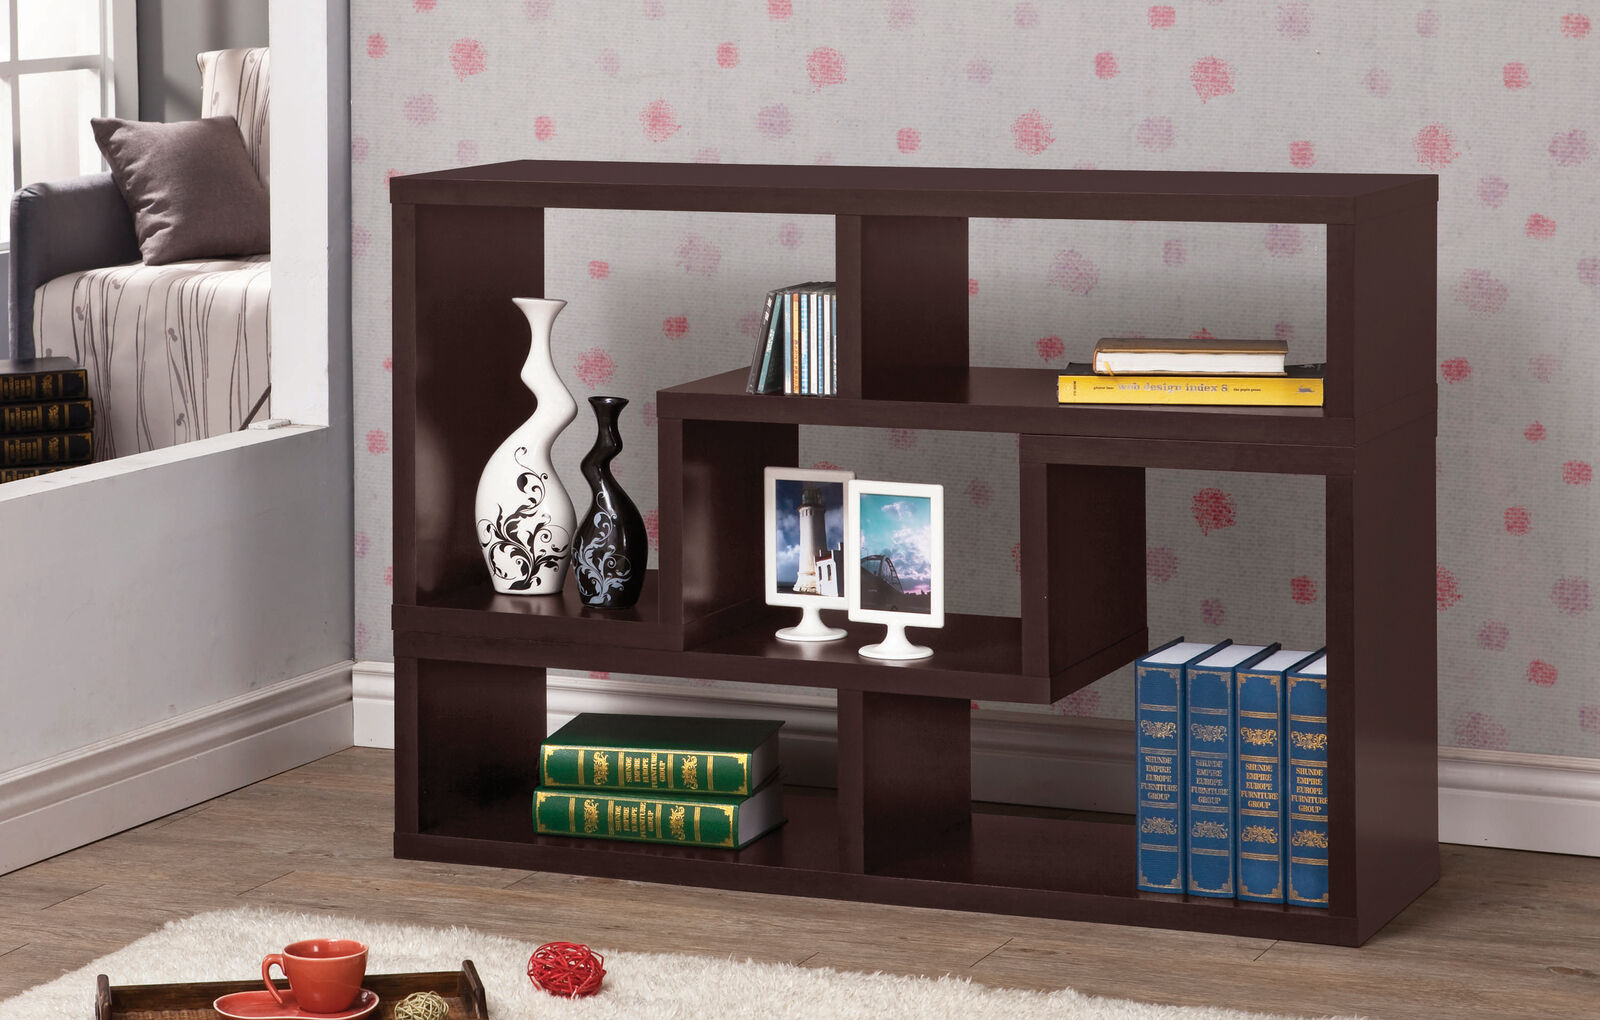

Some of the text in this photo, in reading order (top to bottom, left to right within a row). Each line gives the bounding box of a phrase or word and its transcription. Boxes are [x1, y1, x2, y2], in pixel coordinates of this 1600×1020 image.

[1118, 382, 1140, 391] web
[1143, 382, 1182, 393] design
[1185, 383, 1218, 392] index
[1221, 384, 1228, 392] 8
[1145, 755, 1172, 764] SHUNDE
[1195, 759, 1223, 768] SHUNDE
[1146, 765, 1171, 774] EMPIRE
[1245, 763, 1273, 772] SHUNDE
[1295, 767, 1323, 777] SHUNDE
[1196, 768, 1222, 777] EMPIRE
[1246, 772, 1272, 781] EMPIRE
[1145, 774, 1172, 783] EUROPE
[1196, 777, 1223, 786] EUROPE
[1296, 776, 1322, 786] EMPIRE
[1140, 782, 1178, 792] FURNITURE
[1191, 786, 1229, 796] FURNITURE
[1245, 782, 1272, 791] EUROPE
[1296, 785, 1323, 795] EUROPE
[1147, 792, 1170, 801] GROUP
[1240, 790, 1278, 800] FURNITURE
[1198, 796, 1221, 804] GROUP
[1247, 800, 1271, 809] GROUP
[1298, 804, 1322, 813] GROUP
